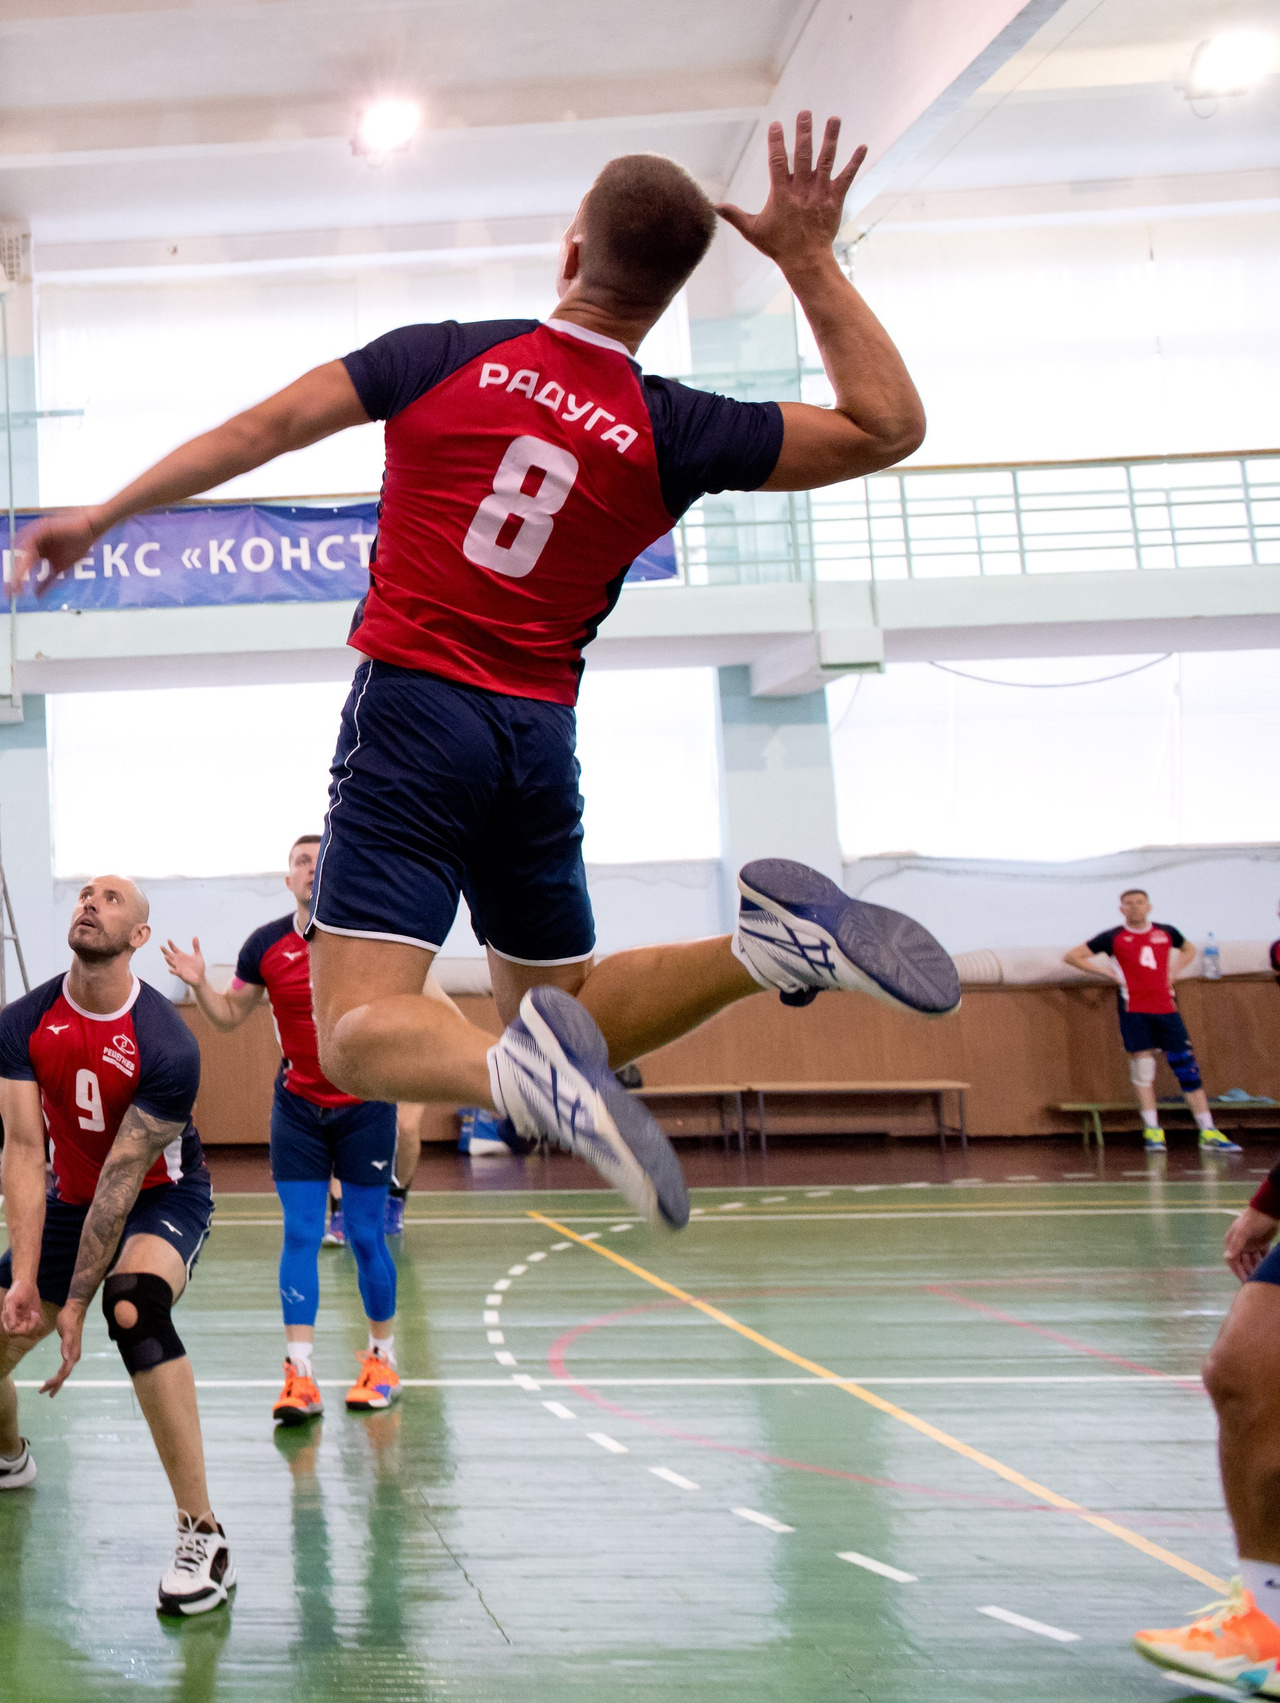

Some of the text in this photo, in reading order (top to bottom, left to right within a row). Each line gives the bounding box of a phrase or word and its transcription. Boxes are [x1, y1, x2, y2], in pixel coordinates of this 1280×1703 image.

[478, 362, 639, 454] РАДУГА
[462, 434, 579, 578] 8
[1139, 945, 1158, 970] 4
[75, 1068, 106, 1132] 9
